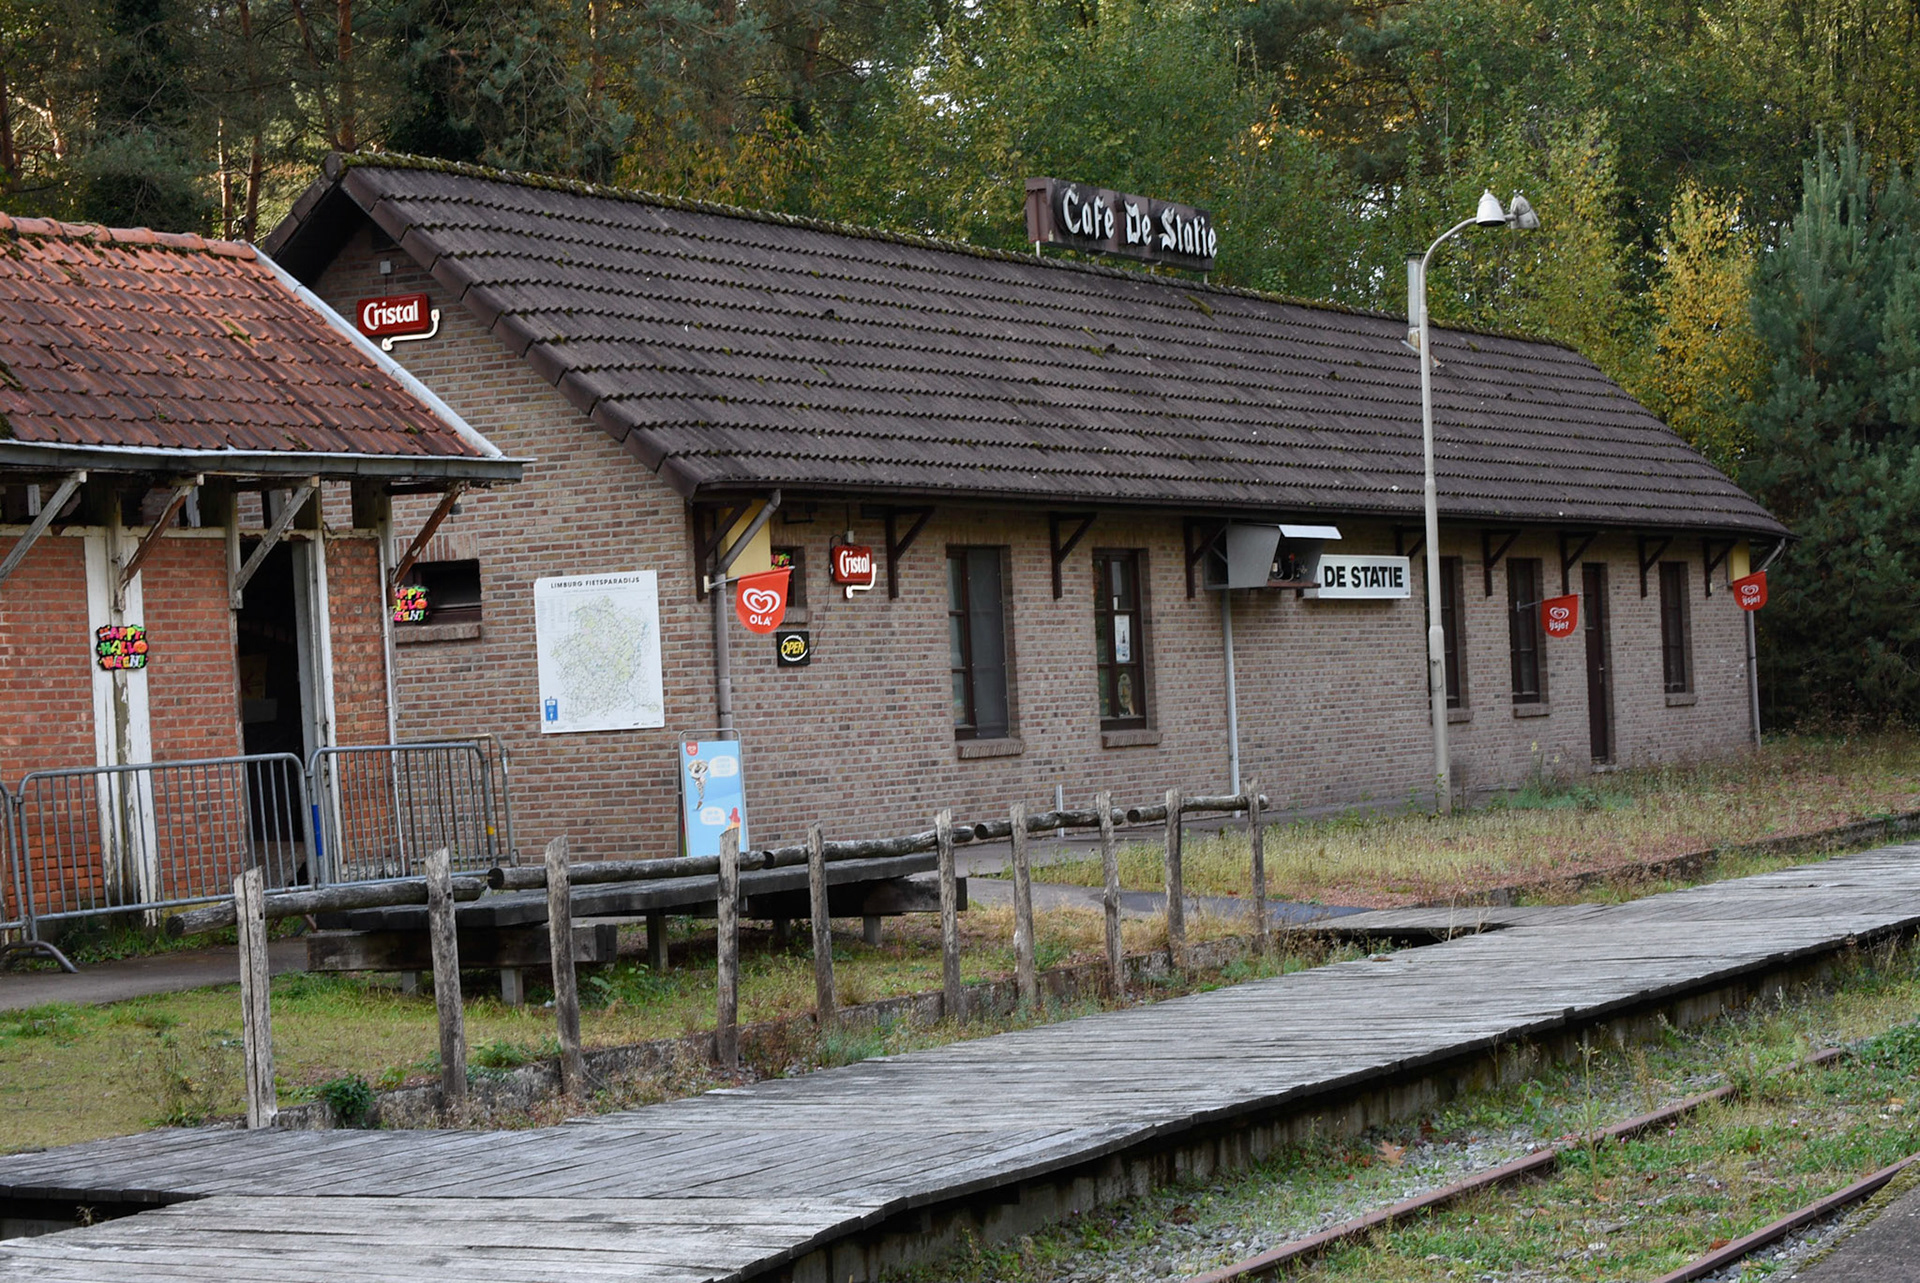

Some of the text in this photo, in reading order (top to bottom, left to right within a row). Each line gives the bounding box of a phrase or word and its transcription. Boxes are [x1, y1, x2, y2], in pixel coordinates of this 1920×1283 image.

[1062, 184, 1218, 259] Cafe De Statie
[363, 300, 419, 331] Cristal
[840, 550, 870, 578] Cristal
[550, 576, 640, 589] LIMBURG FIETSPARADIJS
[1323, 565, 1404, 588] DE STATIE
[749, 614, 771, 626] OLA
[781, 641, 805, 655] OPEN
